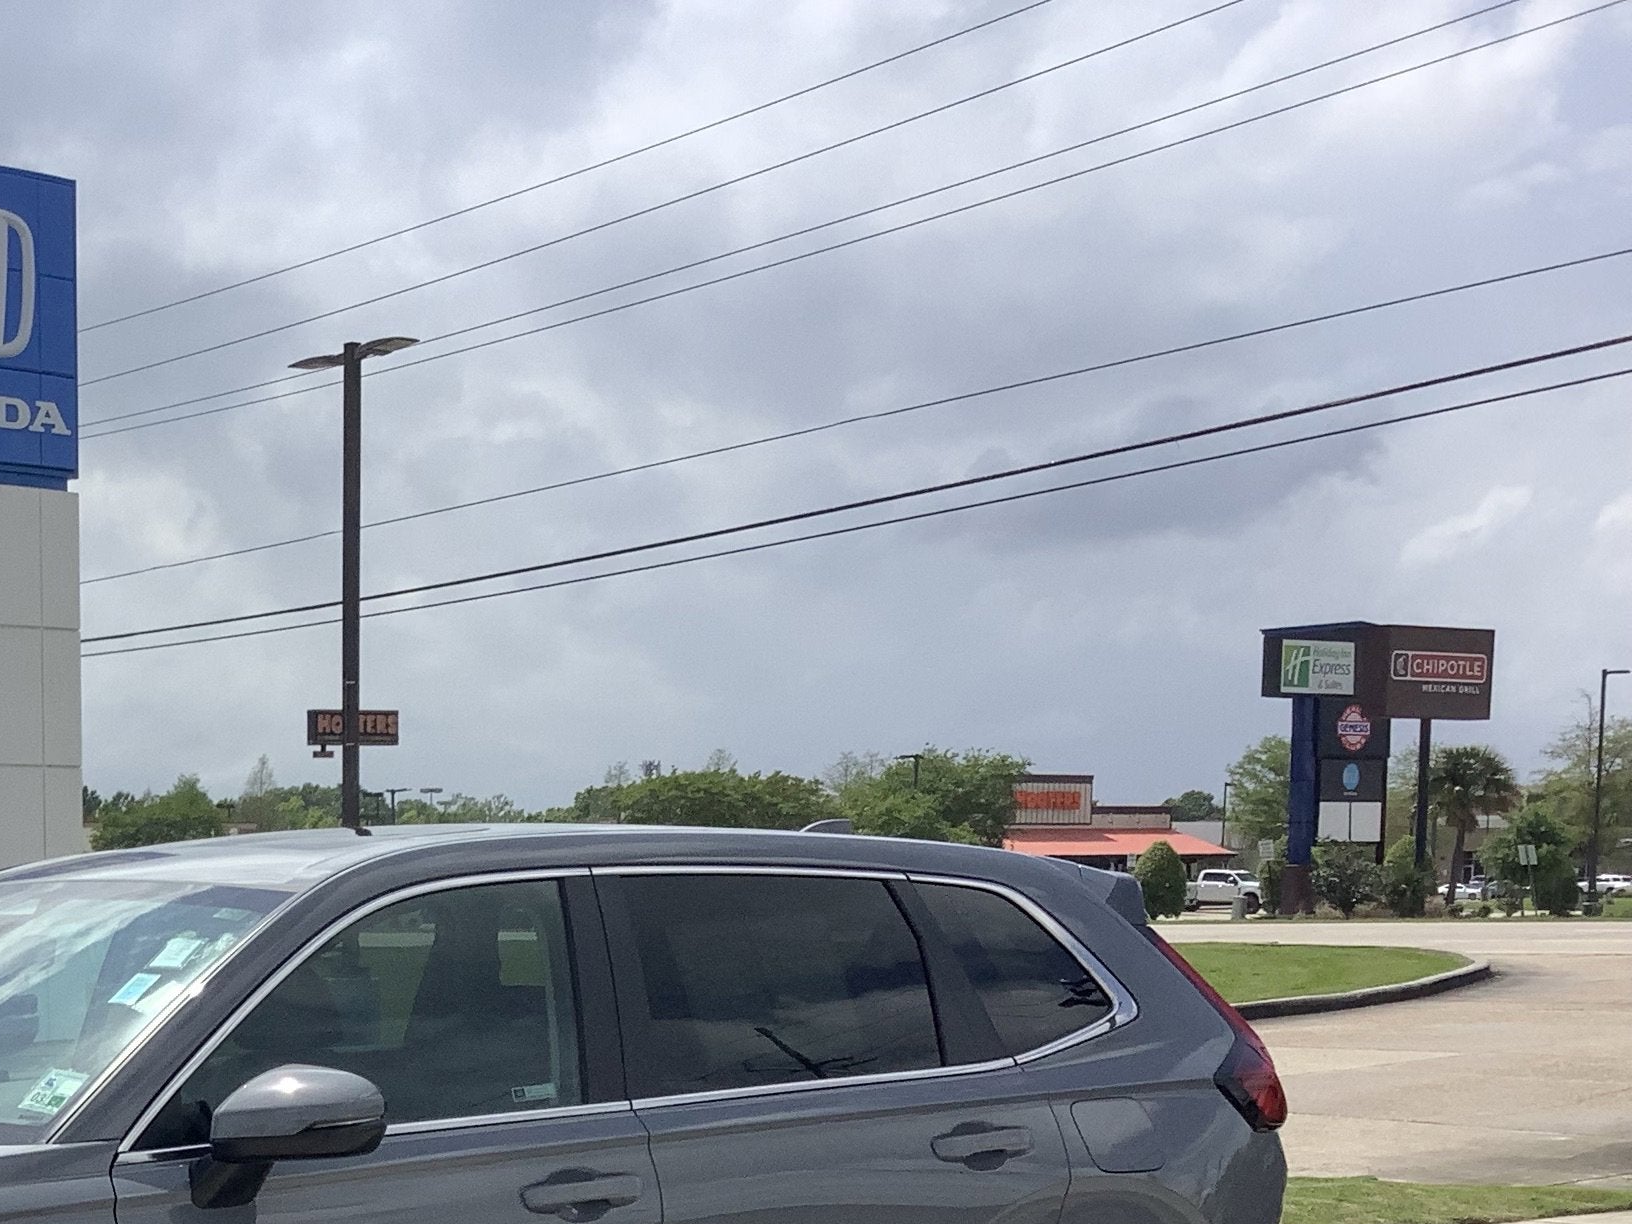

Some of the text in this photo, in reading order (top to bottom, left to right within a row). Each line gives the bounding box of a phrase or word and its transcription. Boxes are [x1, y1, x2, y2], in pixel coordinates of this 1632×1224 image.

[1311, 658, 1351, 677] Express
[1413, 658, 1483, 676] CHIPOTLE
[1422, 684, 1480, 695] MEXICAN GRILL
[317, 713, 397, 735] HOTERS
